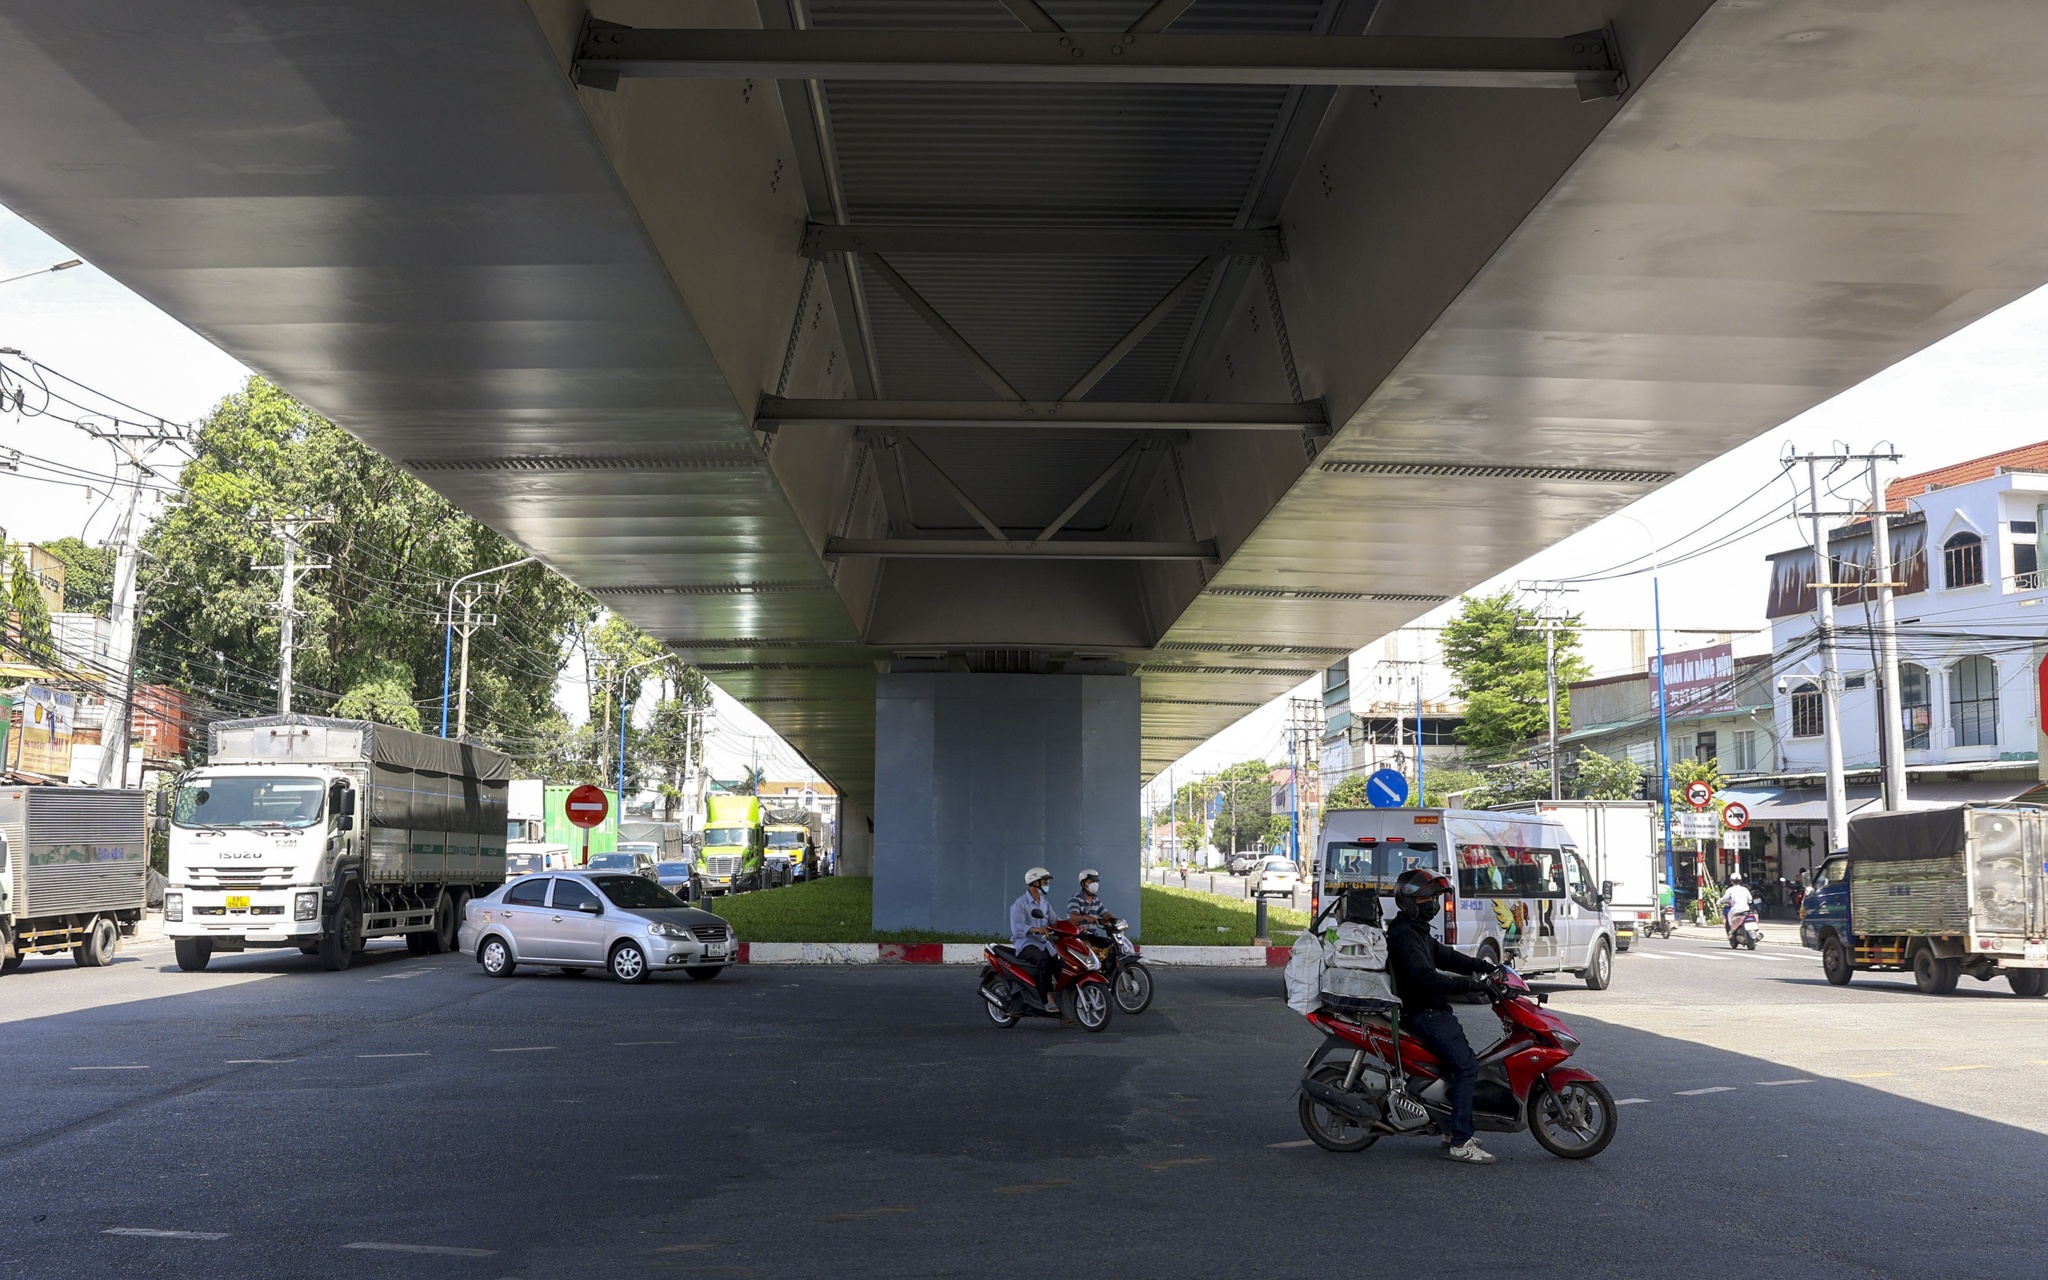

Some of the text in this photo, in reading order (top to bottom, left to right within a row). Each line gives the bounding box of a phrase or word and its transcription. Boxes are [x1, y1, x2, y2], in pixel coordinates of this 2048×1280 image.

[1663, 660, 1683, 686] QUÁN
[1683, 658, 1695, 682] ĂN
[219, 851, 262, 859] ISUZU
